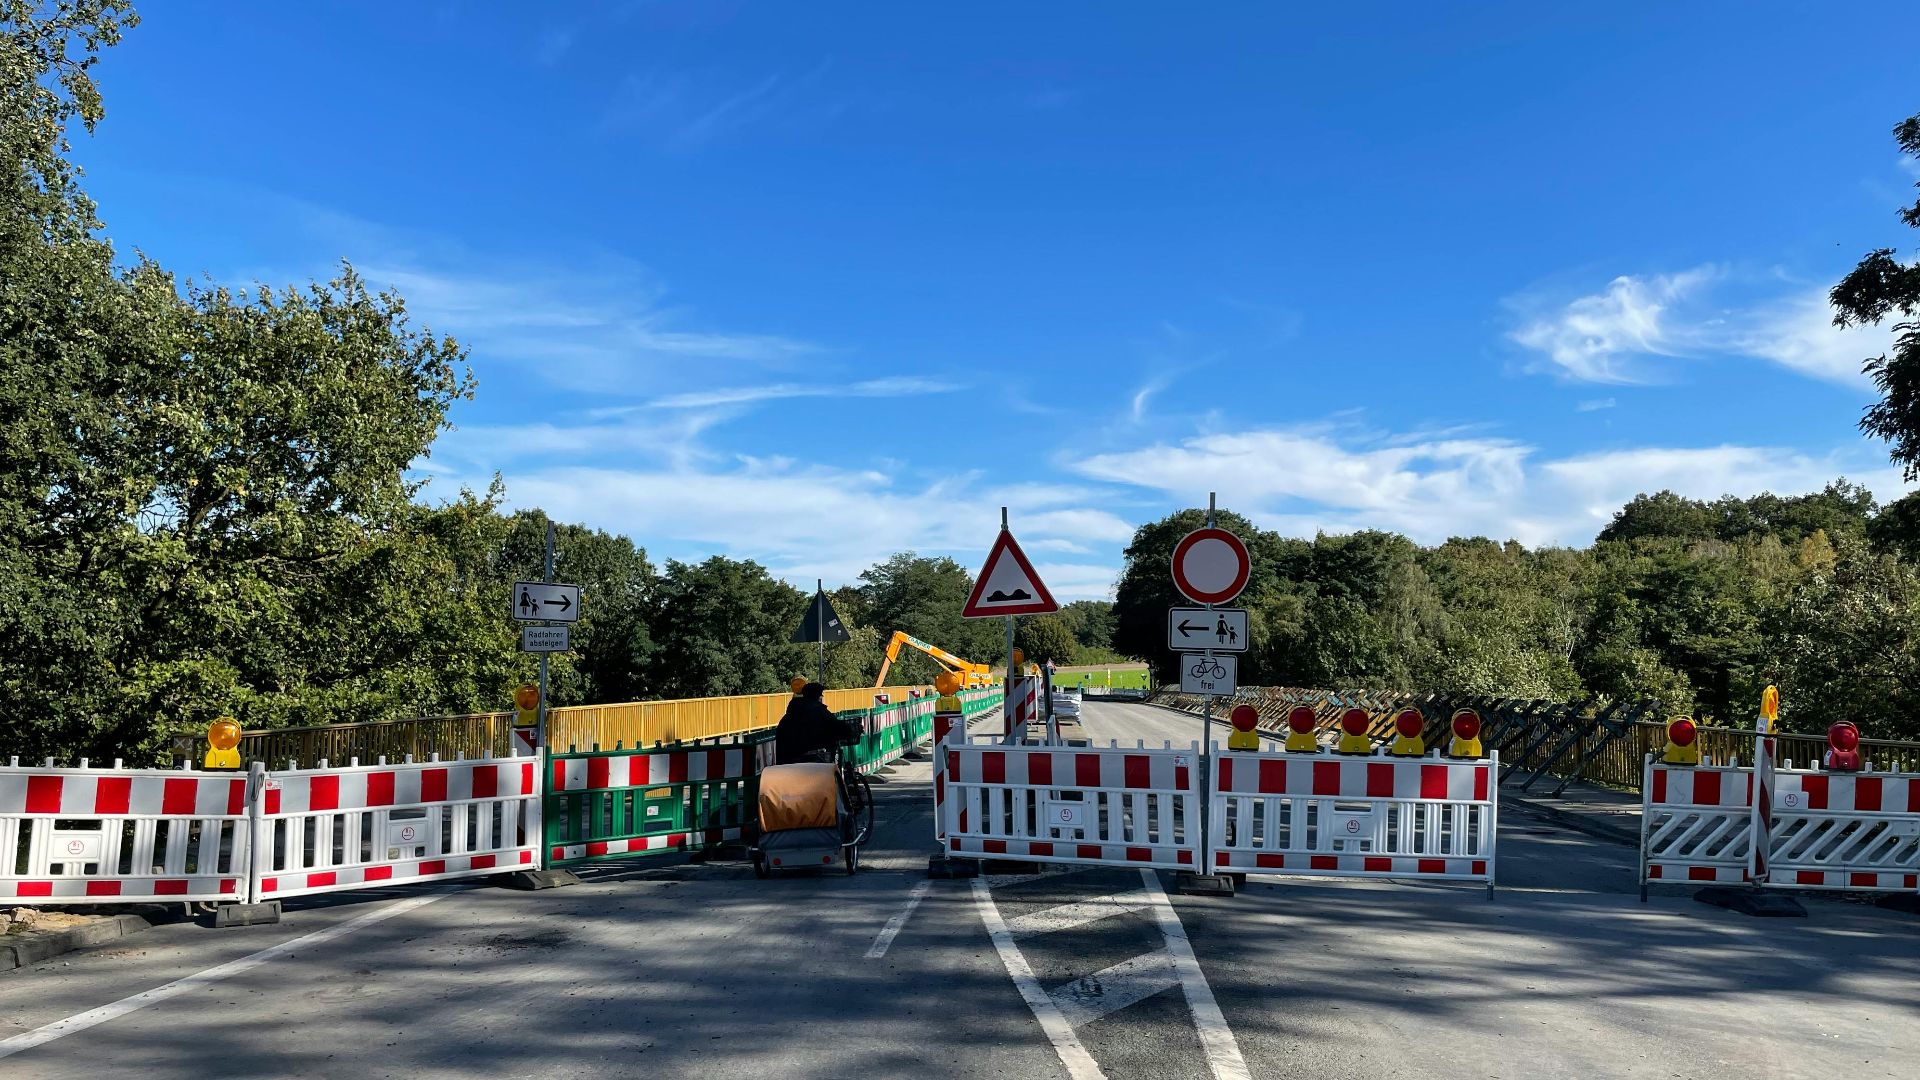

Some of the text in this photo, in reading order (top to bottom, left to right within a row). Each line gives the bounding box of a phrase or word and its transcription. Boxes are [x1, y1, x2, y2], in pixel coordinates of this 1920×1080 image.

[528, 630, 564, 638] Radfahrer
[529, 639, 564, 647] absteigen
[1200, 680, 1215, 690] frei
